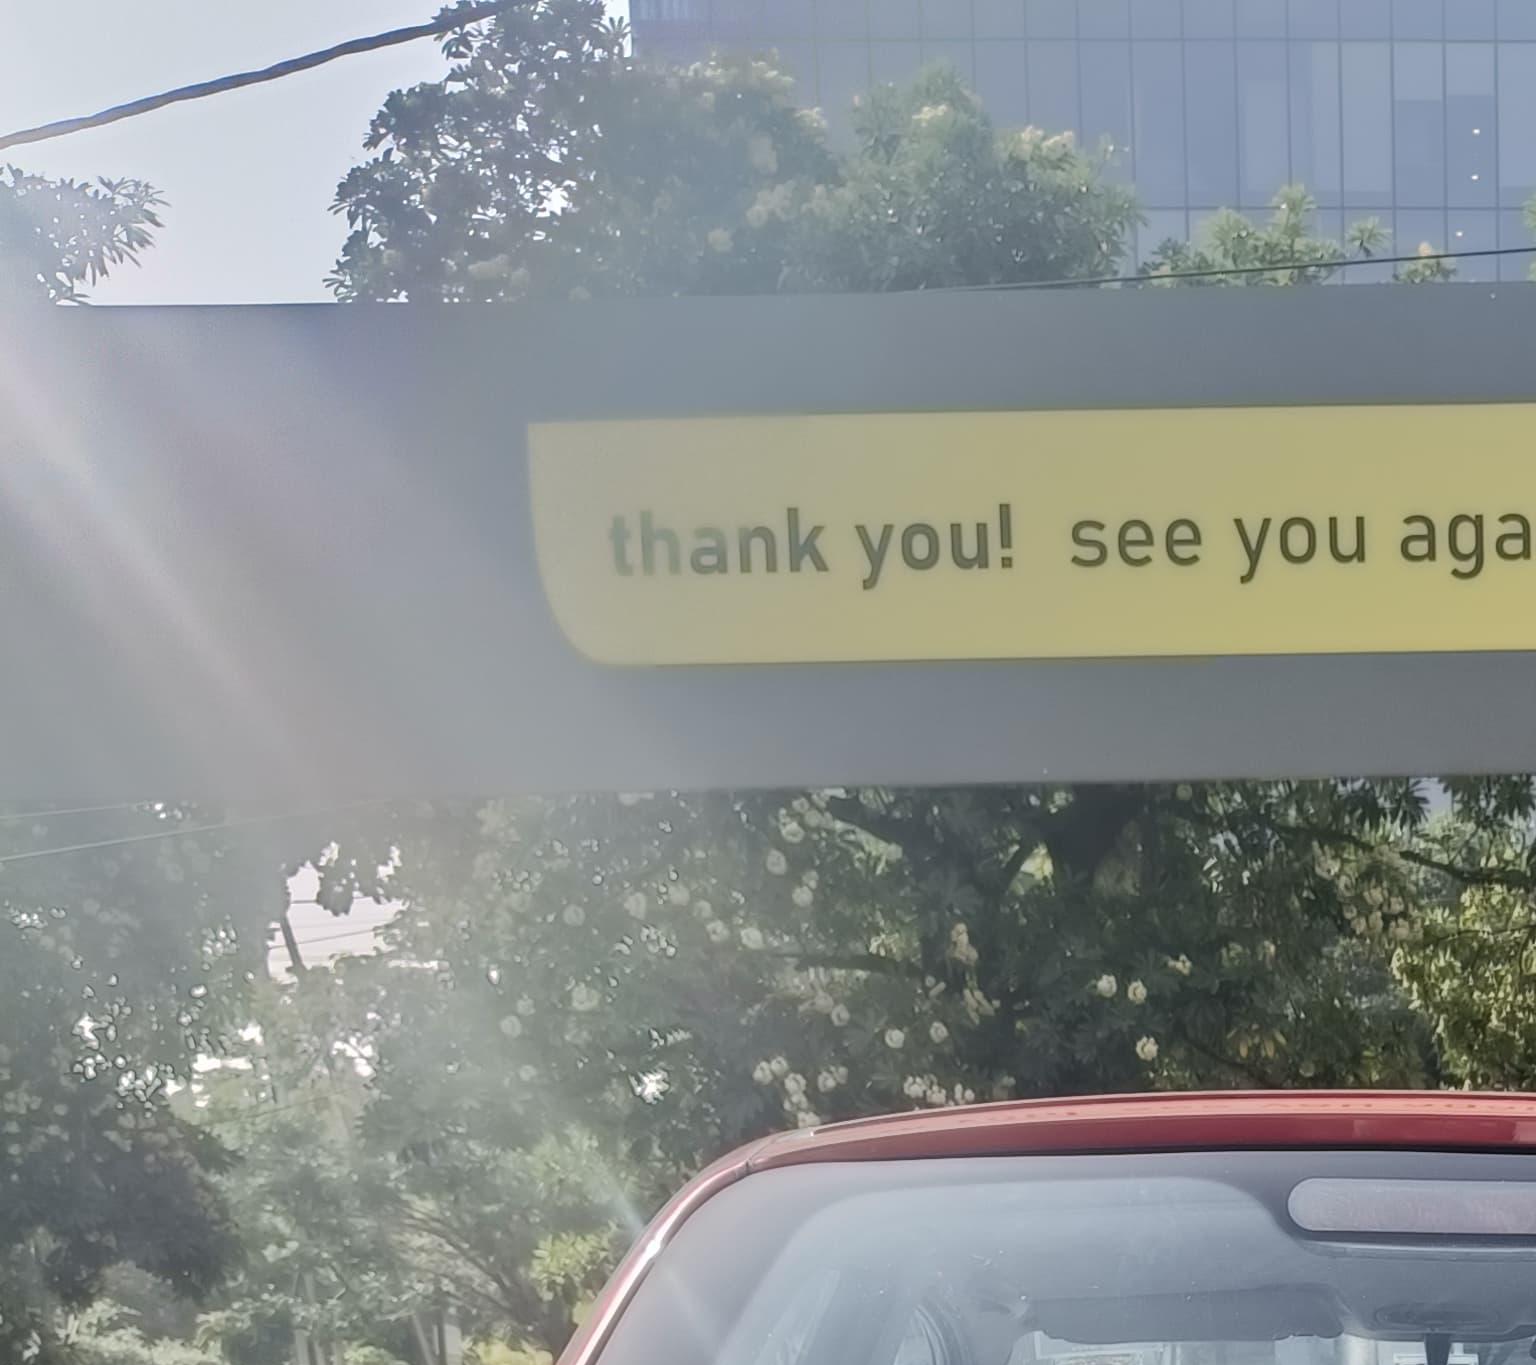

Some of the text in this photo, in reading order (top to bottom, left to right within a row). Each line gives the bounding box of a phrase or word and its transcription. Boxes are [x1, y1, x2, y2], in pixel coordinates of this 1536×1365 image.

[609, 507, 829, 577] thank
[854, 502, 1014, 590] you!
[1069, 517, 1203, 567] see
[1233, 515, 1367, 584] you
